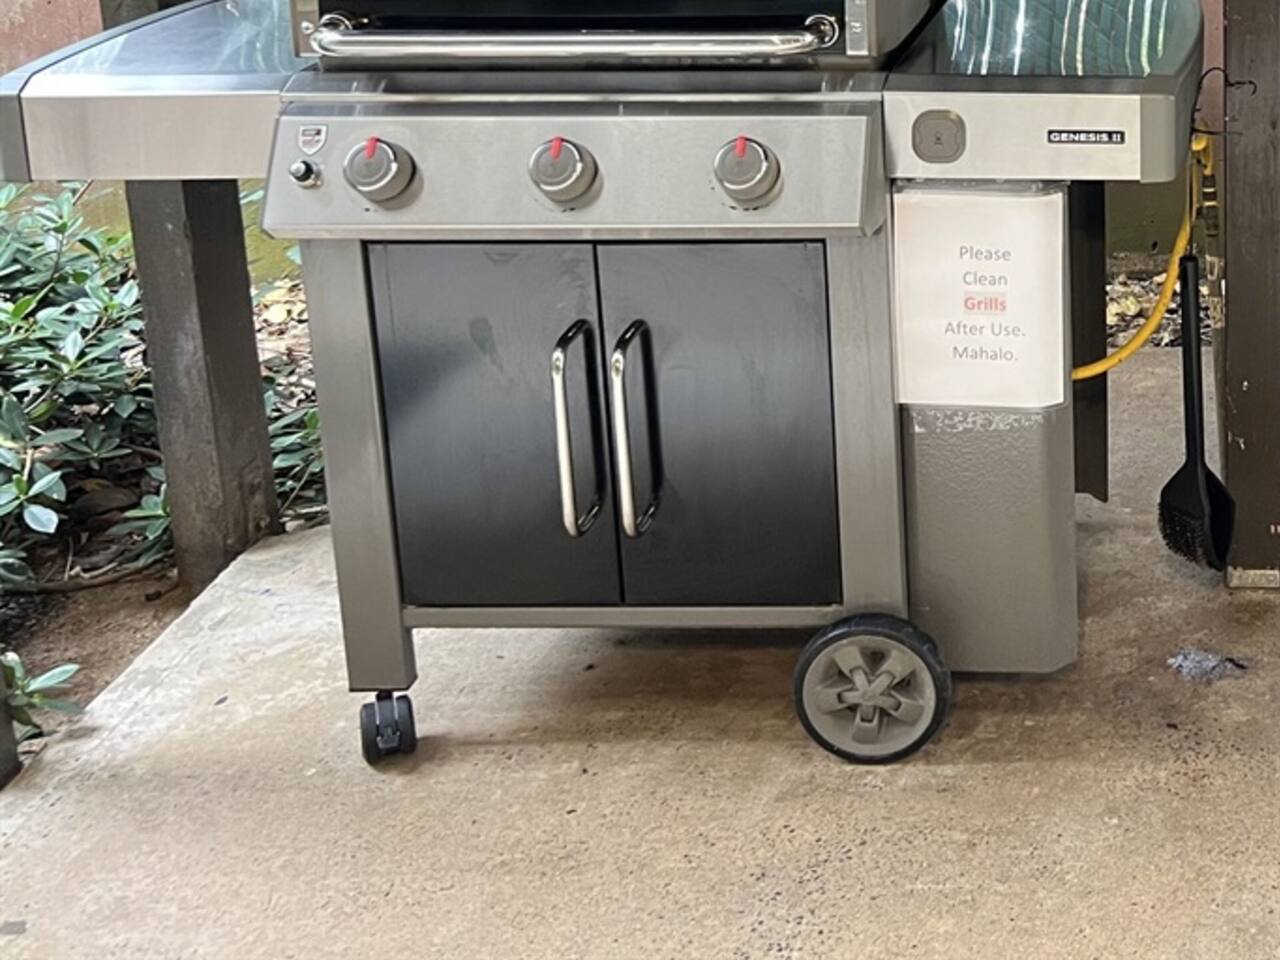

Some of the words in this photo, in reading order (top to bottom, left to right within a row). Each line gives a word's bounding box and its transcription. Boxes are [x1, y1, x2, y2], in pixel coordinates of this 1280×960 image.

[1049, 132, 1109, 142] GENESIS
[1111, 132, 1121, 142] II
[959, 245, 1012, 261] Please
[962, 271, 1008, 286] Clean
[963, 296, 1007, 312] Grills
[944, 321, 986, 336] After
[990, 322, 1027, 337] Use.
[952, 346, 1019, 361] Mahalo.
